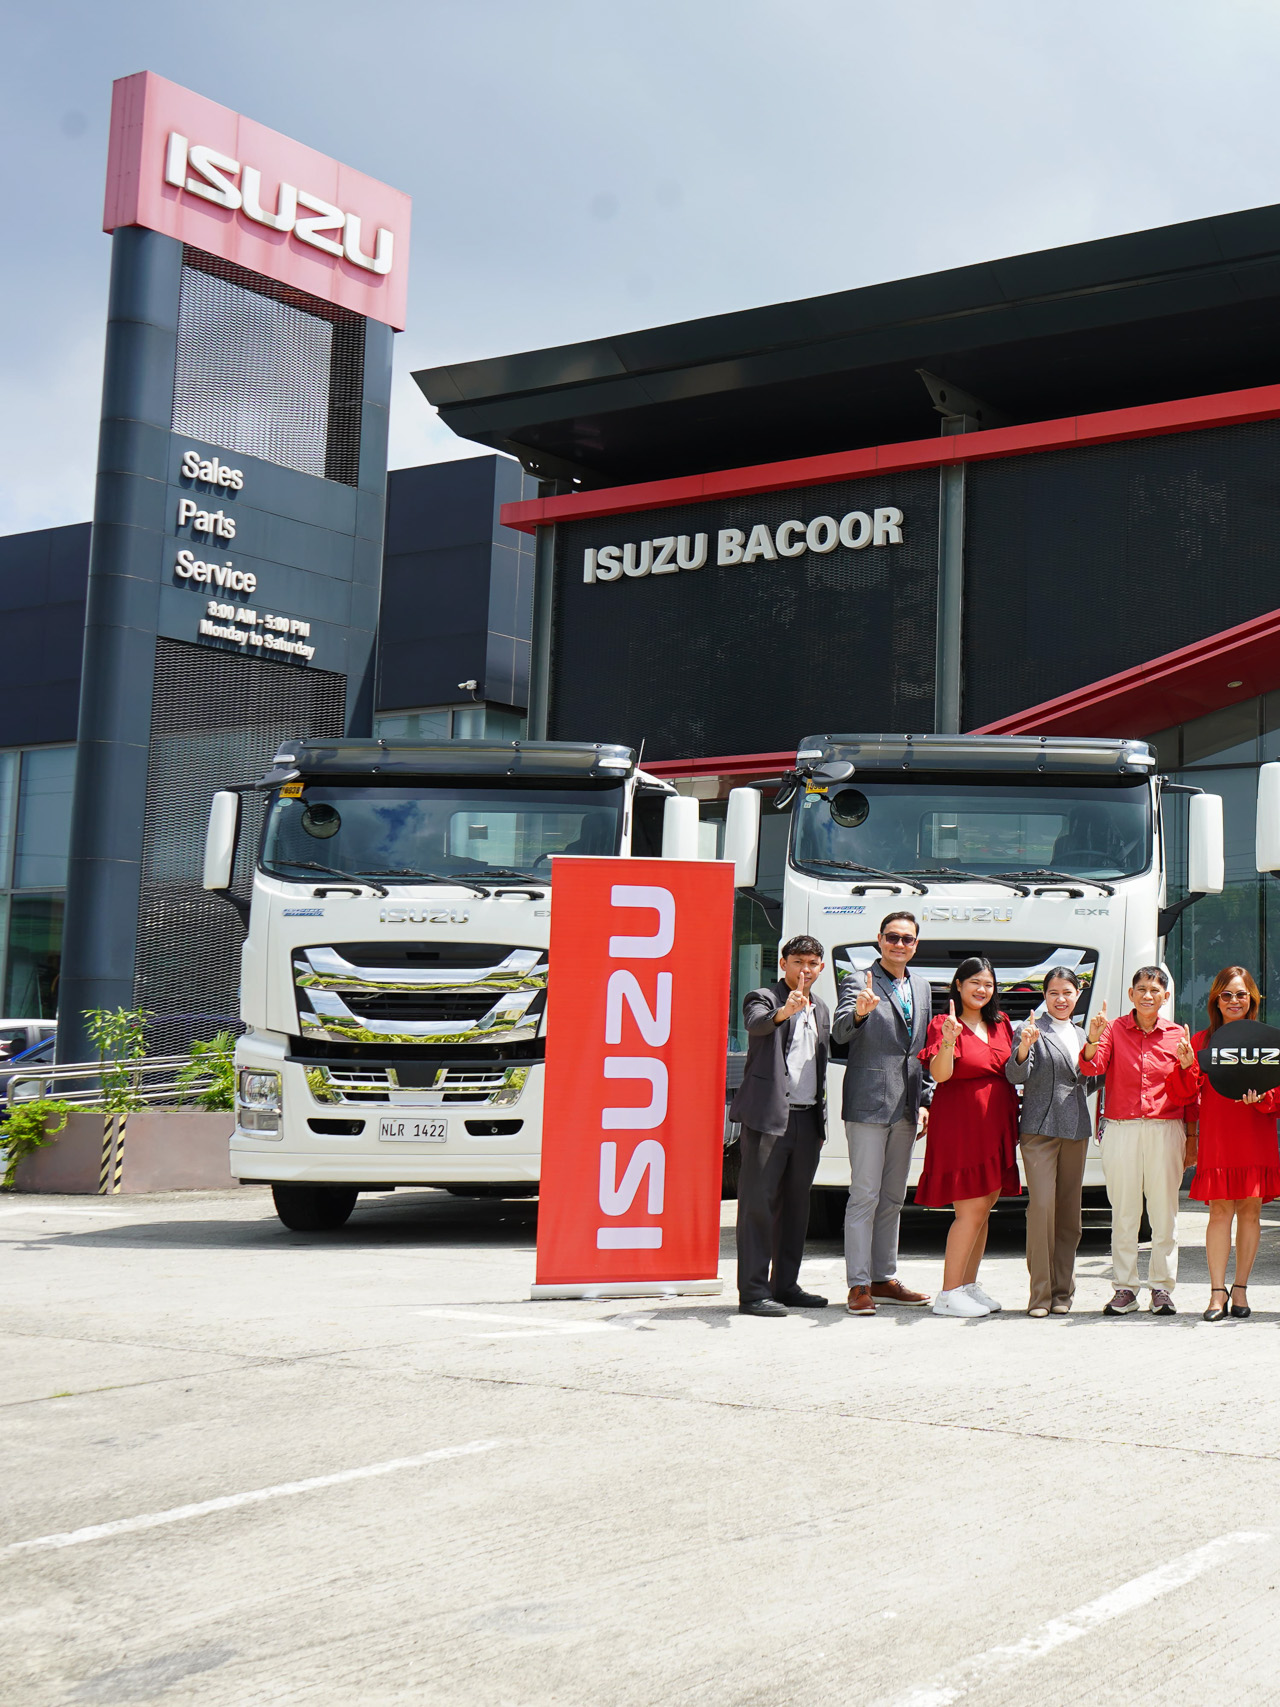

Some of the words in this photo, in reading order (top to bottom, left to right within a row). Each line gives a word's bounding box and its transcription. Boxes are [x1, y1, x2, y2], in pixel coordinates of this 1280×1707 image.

[165, 131, 394, 275] ISUZU
[182, 451, 244, 490] Sales
[178, 498, 236, 539] Parts
[583, 533, 709, 584] ISUZU
[717, 506, 904, 567] BACOOR
[175, 550, 257, 593] Service
[200, 619, 249, 646] Monday
[249, 631, 263, 646] to
[263, 634, 315, 661] Saturday
[235, 608, 257, 625] AM
[264, 614, 290, 632] 5:00
[290, 620, 311, 637] PM
[379, 907, 470, 924] ISUZU
[922, 905, 1013, 922] ISUZU
[1074, 908, 1110, 916] EXR
[597, 884, 676, 1250] ISUZU
[381, 1123, 405, 1137] NLR
[413, 1124, 445, 1137] 1422
